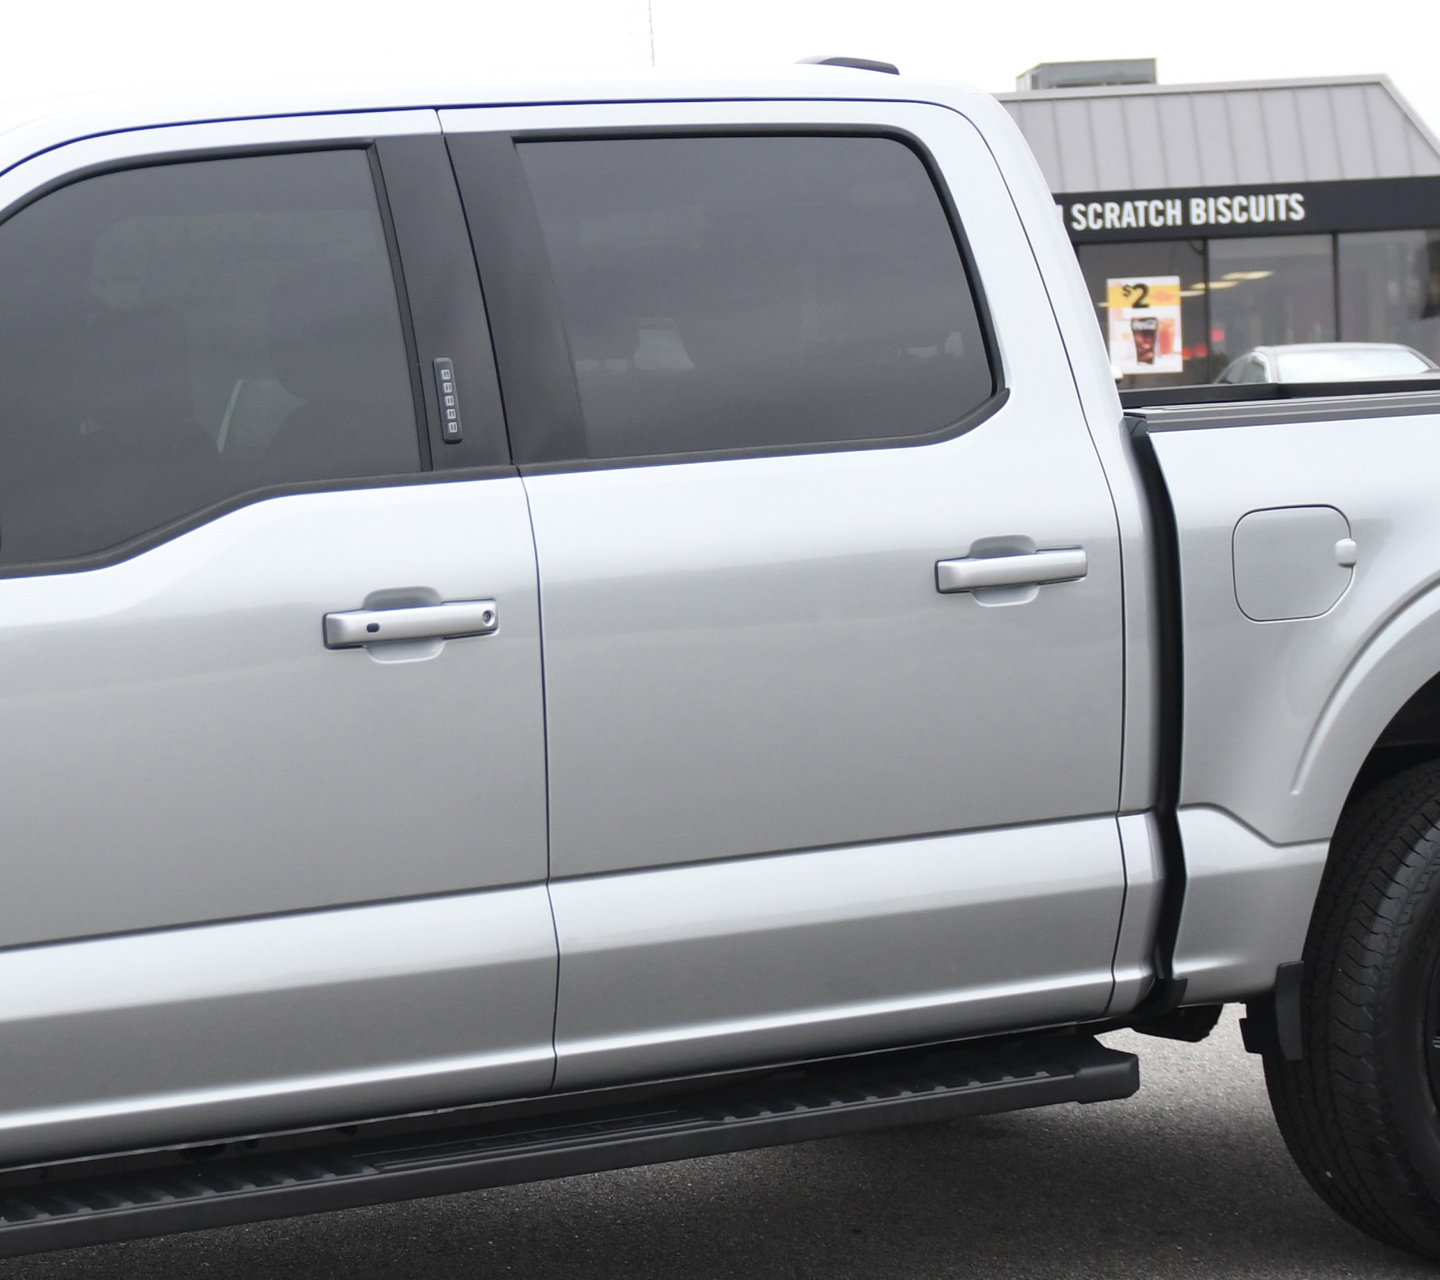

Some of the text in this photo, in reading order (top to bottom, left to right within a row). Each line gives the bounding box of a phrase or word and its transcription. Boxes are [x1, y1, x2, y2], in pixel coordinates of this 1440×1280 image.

[1071, 199, 1182, 231] SCRATCH
[1189, 193, 1306, 225] BISCUITS
[1122, 283, 1150, 309] $2
